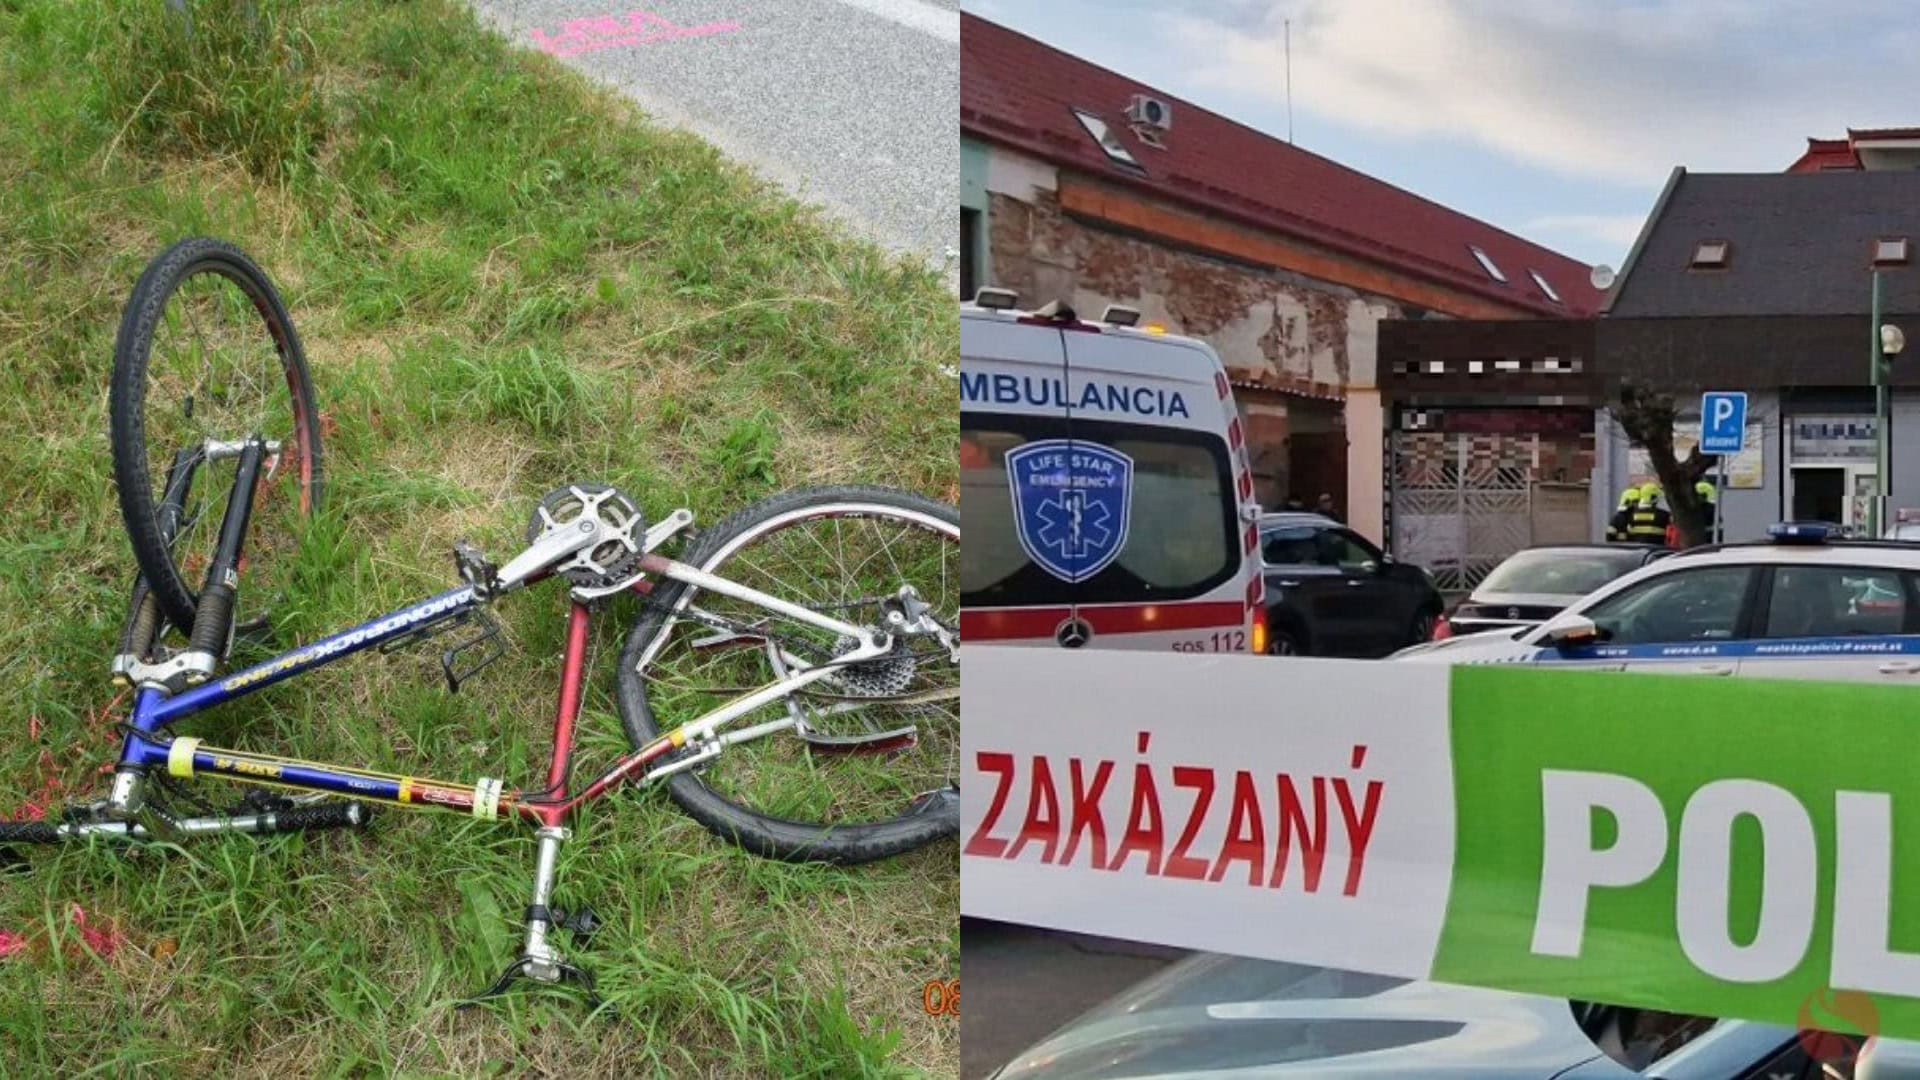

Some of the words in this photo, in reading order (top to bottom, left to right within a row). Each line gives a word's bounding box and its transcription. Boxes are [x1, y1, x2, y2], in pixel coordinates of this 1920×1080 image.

[1713, 398, 1734, 431] P
[1029, 454, 1065, 471] LIFE
[1071, 455, 1113, 475] STAR
[1029, 473, 1117, 488] EMERGENCY
[1211, 630, 1245, 653] 112
[963, 731, 1384, 897] ZAKÁZANÝ
[1530, 769, 1920, 996] POL
